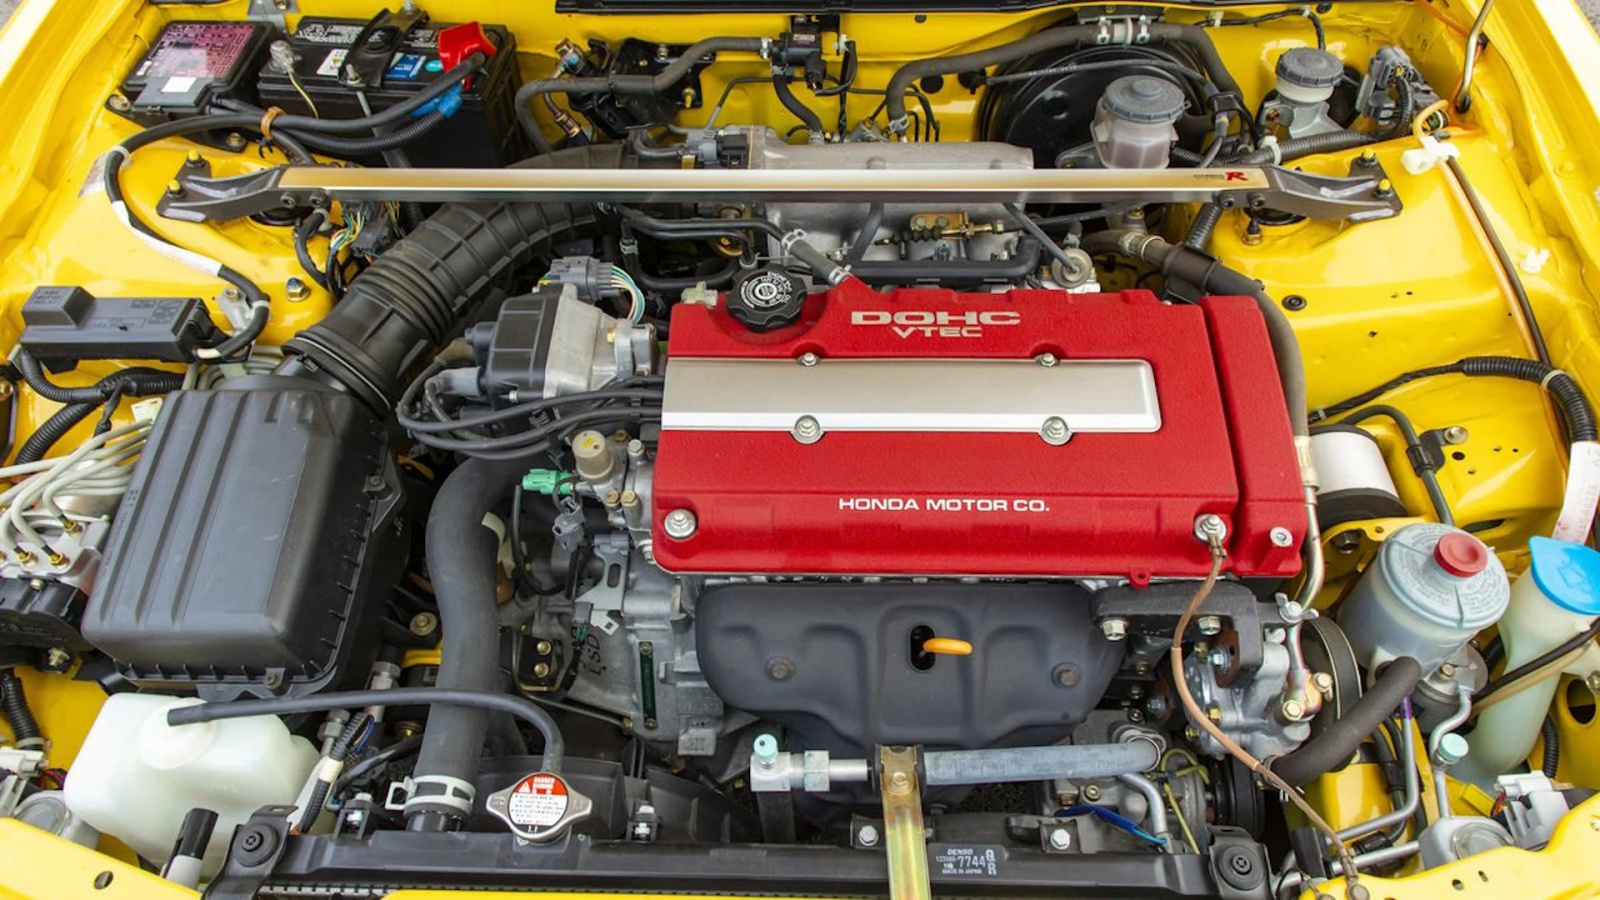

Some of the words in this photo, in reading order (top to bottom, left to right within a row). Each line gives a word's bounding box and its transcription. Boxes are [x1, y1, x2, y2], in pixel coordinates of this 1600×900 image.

[1225, 171, 1249, 181] R
[851, 311, 1021, 326] DOHC
[891, 326, 983, 339] VTEC
[838, 498, 920, 511] HONDA
[926, 498, 1008, 511] MOTOR
[1013, 499, 1050, 512] CO.
